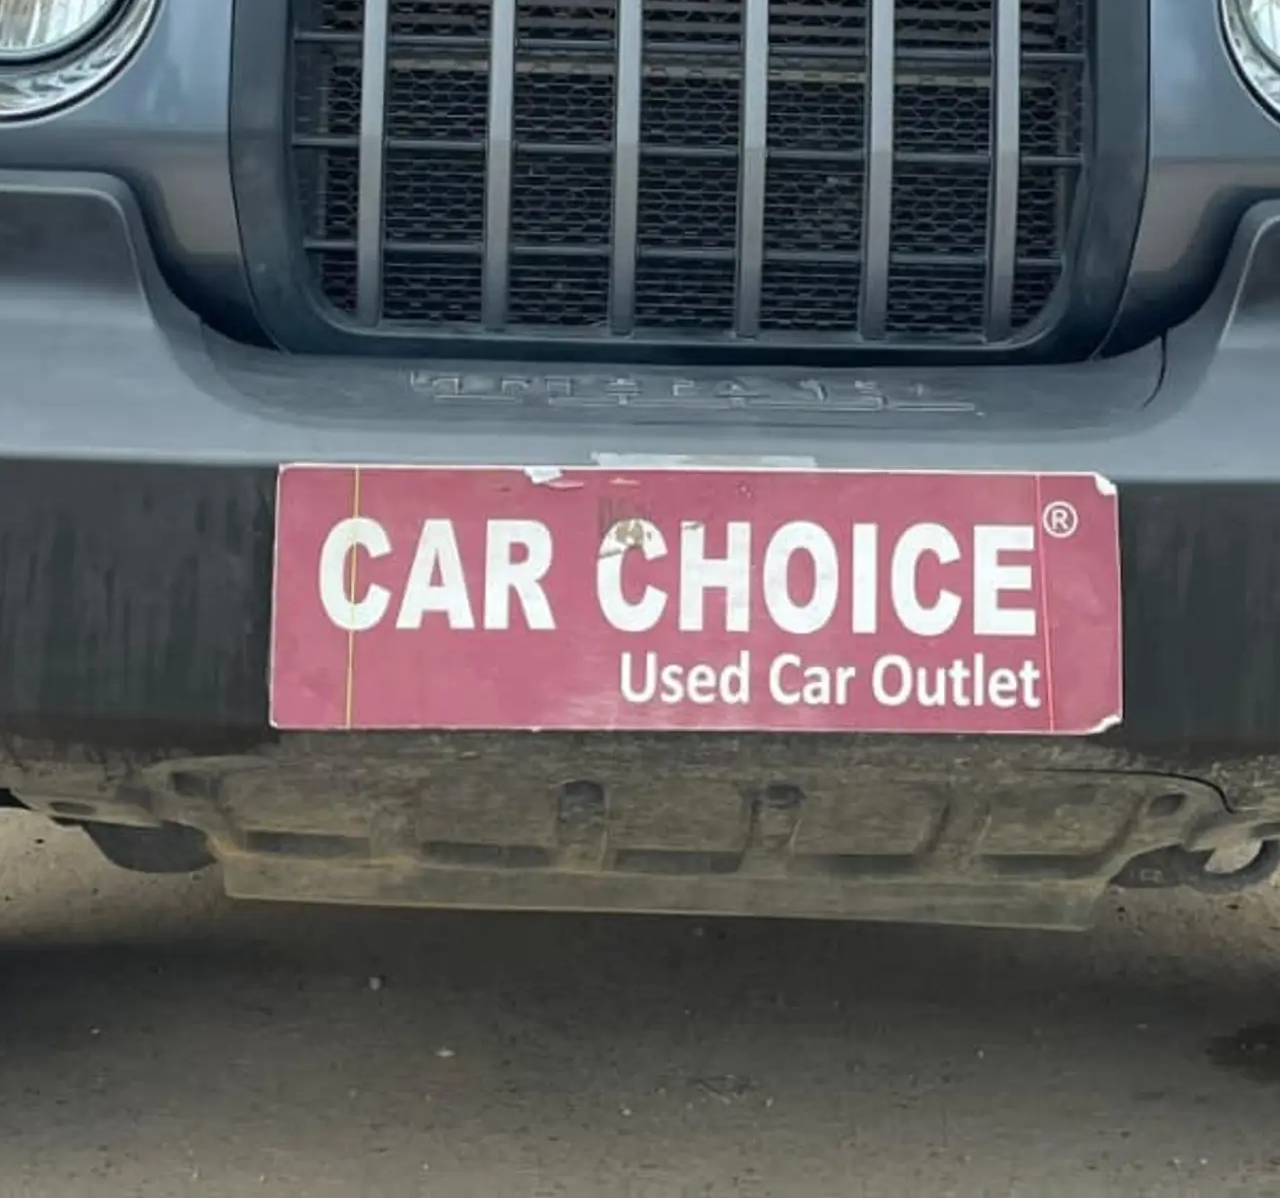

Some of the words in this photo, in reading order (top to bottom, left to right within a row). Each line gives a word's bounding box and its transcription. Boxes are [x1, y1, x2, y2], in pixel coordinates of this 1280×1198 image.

[318, 517, 558, 631] CAR
[596, 517, 1038, 638] CHOICE
[619, 649, 752, 706] Used
[768, 652, 857, 707] Car
[870, 652, 1042, 709] Outlet
